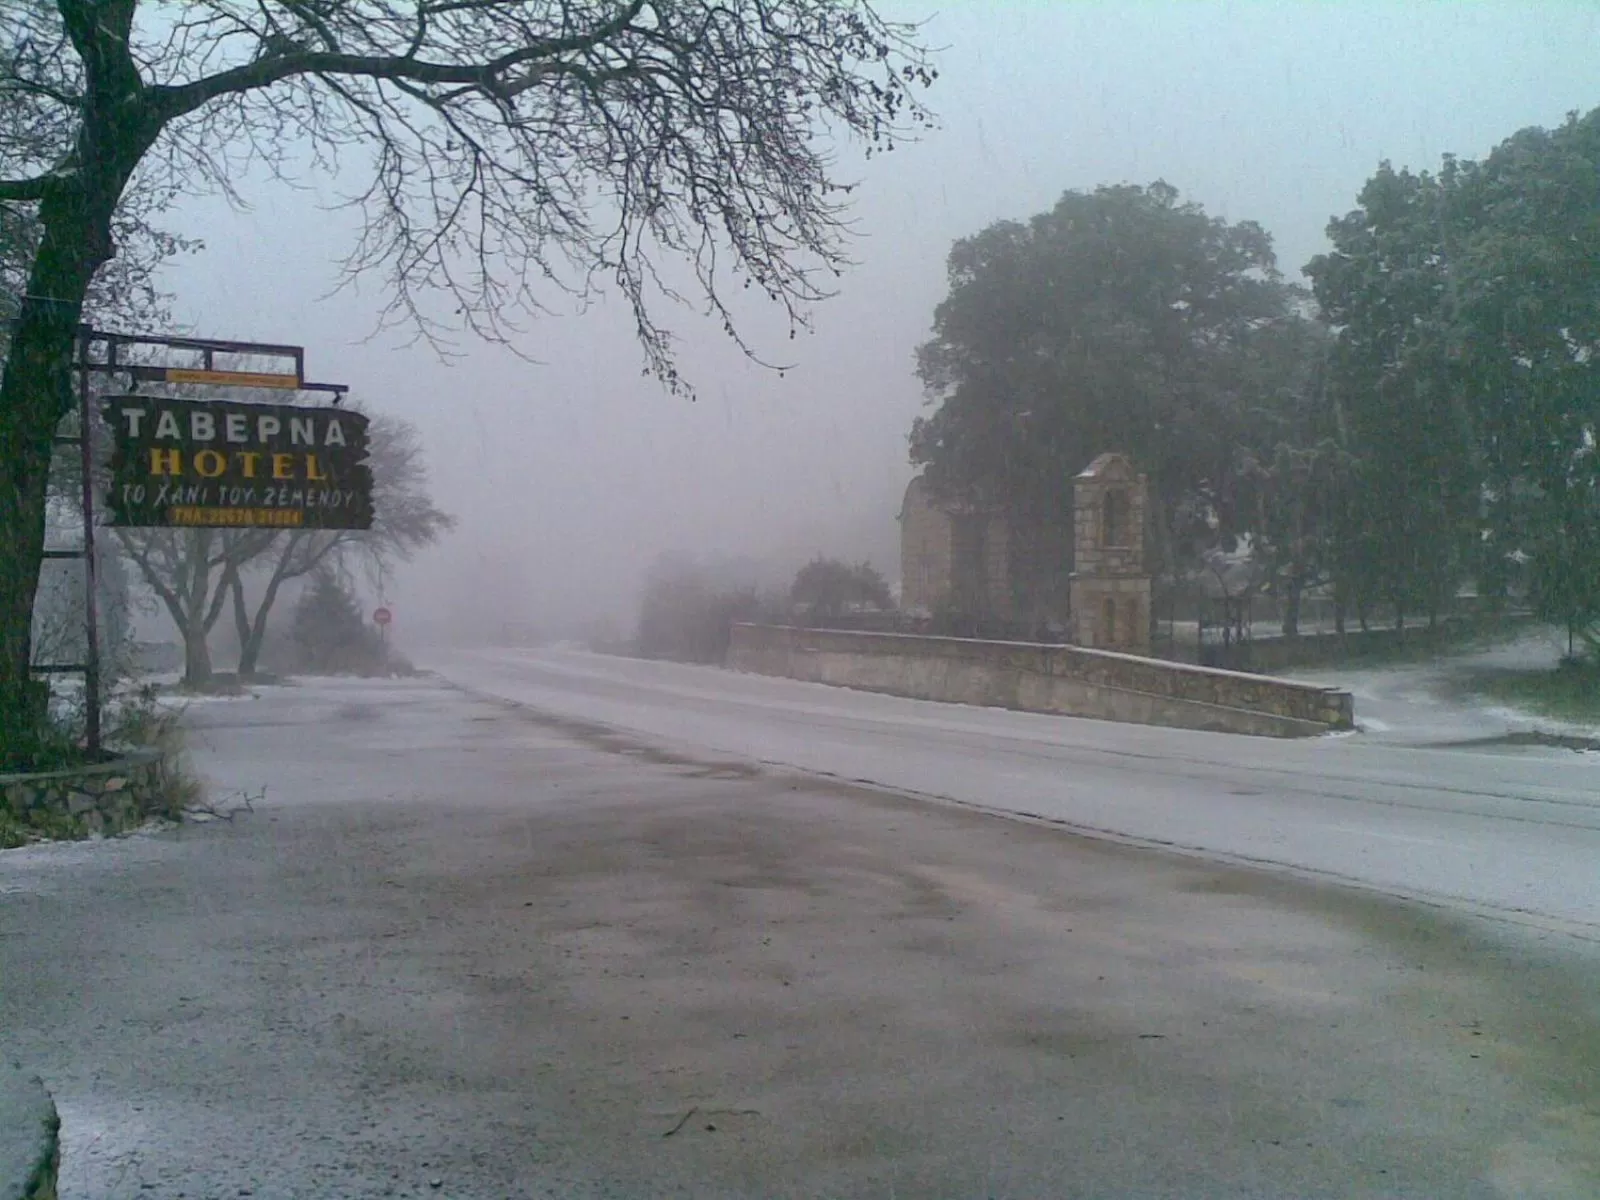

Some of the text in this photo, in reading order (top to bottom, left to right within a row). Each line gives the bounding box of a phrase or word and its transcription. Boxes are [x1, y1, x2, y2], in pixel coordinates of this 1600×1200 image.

[121, 407, 347, 447] ΤΑΒΕΡΝΑ
[149, 447, 327, 480] HOTEL
[123, 483, 146, 505] ΤΟ
[152, 481, 208, 508] ΧΑΝΙ
[218, 484, 256, 506] ΤΟΥ
